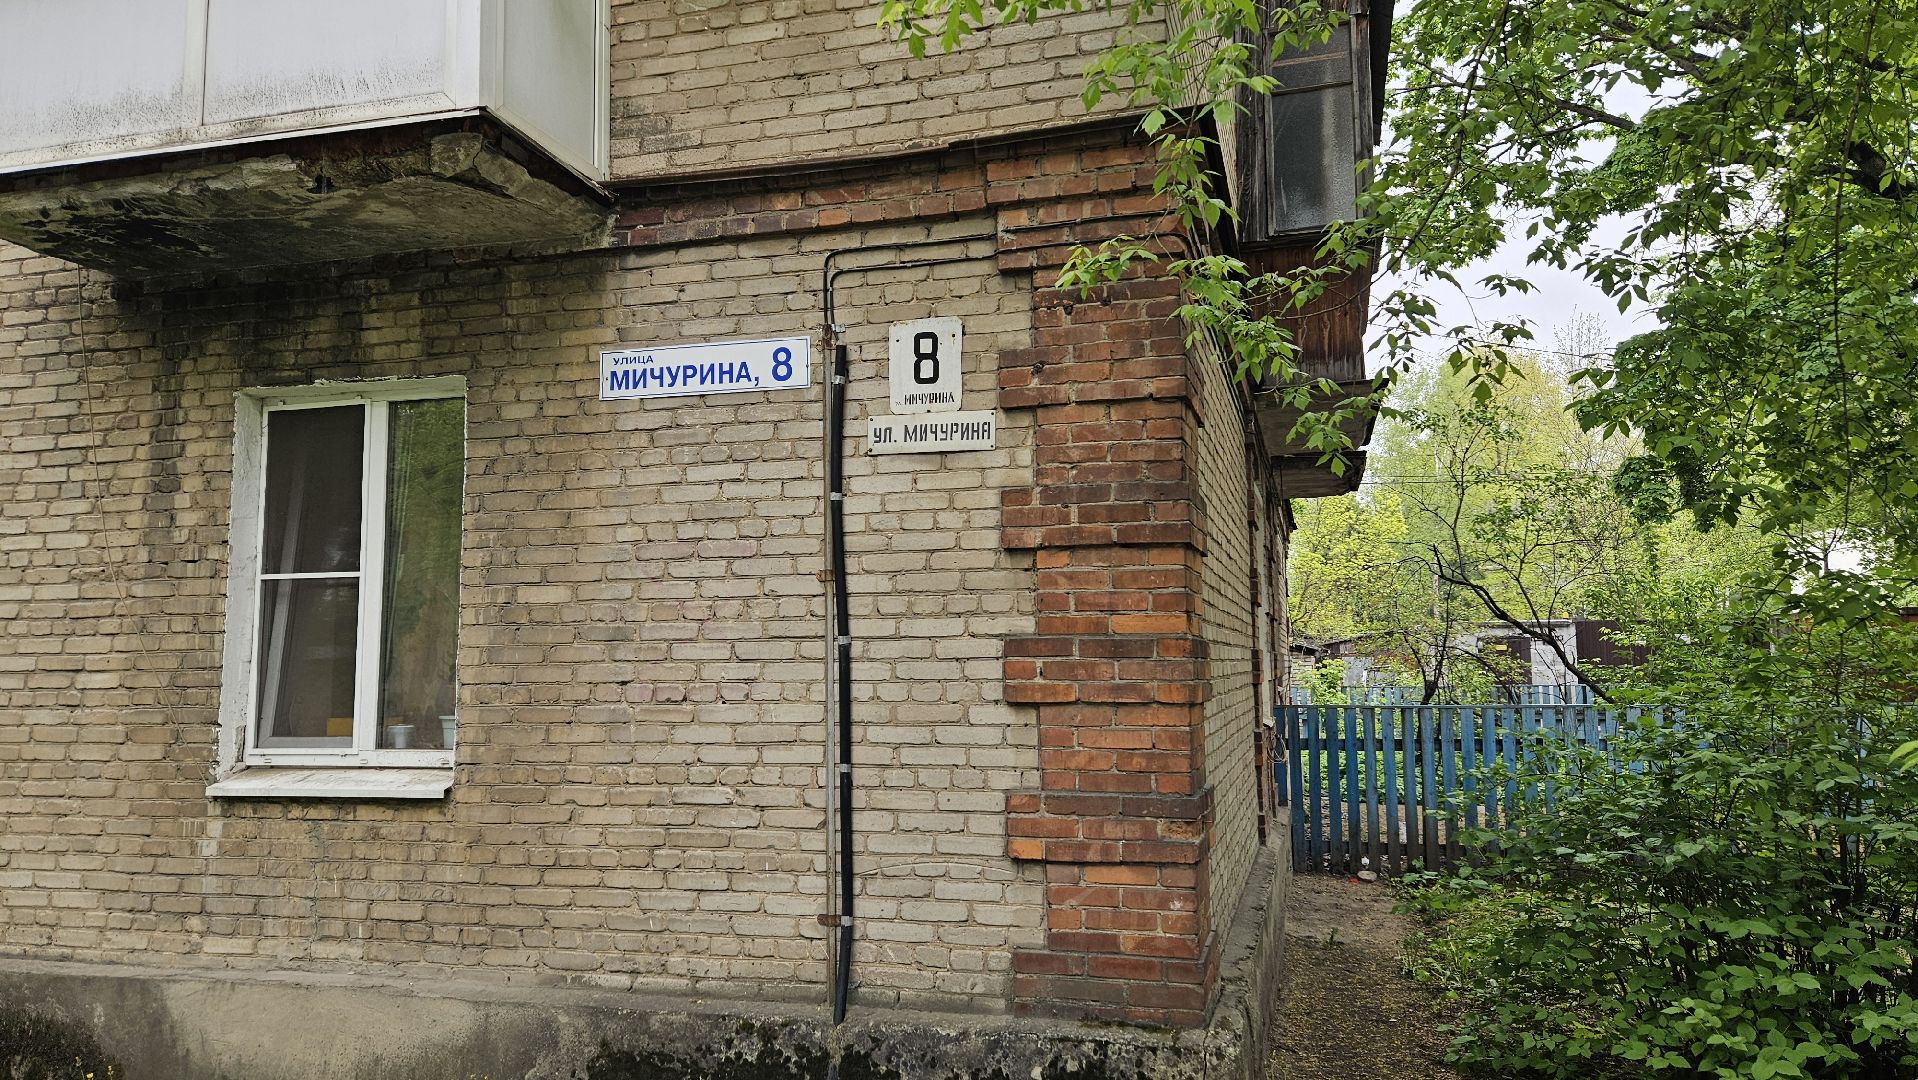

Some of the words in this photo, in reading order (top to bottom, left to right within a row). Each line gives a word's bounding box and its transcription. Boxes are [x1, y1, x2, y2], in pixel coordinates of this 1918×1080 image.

[613, 355, 654, 366] УЛИЦА
[914, 331, 939, 384] 8
[609, 361, 760, 391] МИЧУРИНА,
[771, 347, 793, 382] 8
[904, 392, 955, 405] МИЧУРИНА
[873, 427, 897, 443] УЛ.
[903, 422, 991, 442] МИЧУРИНА
